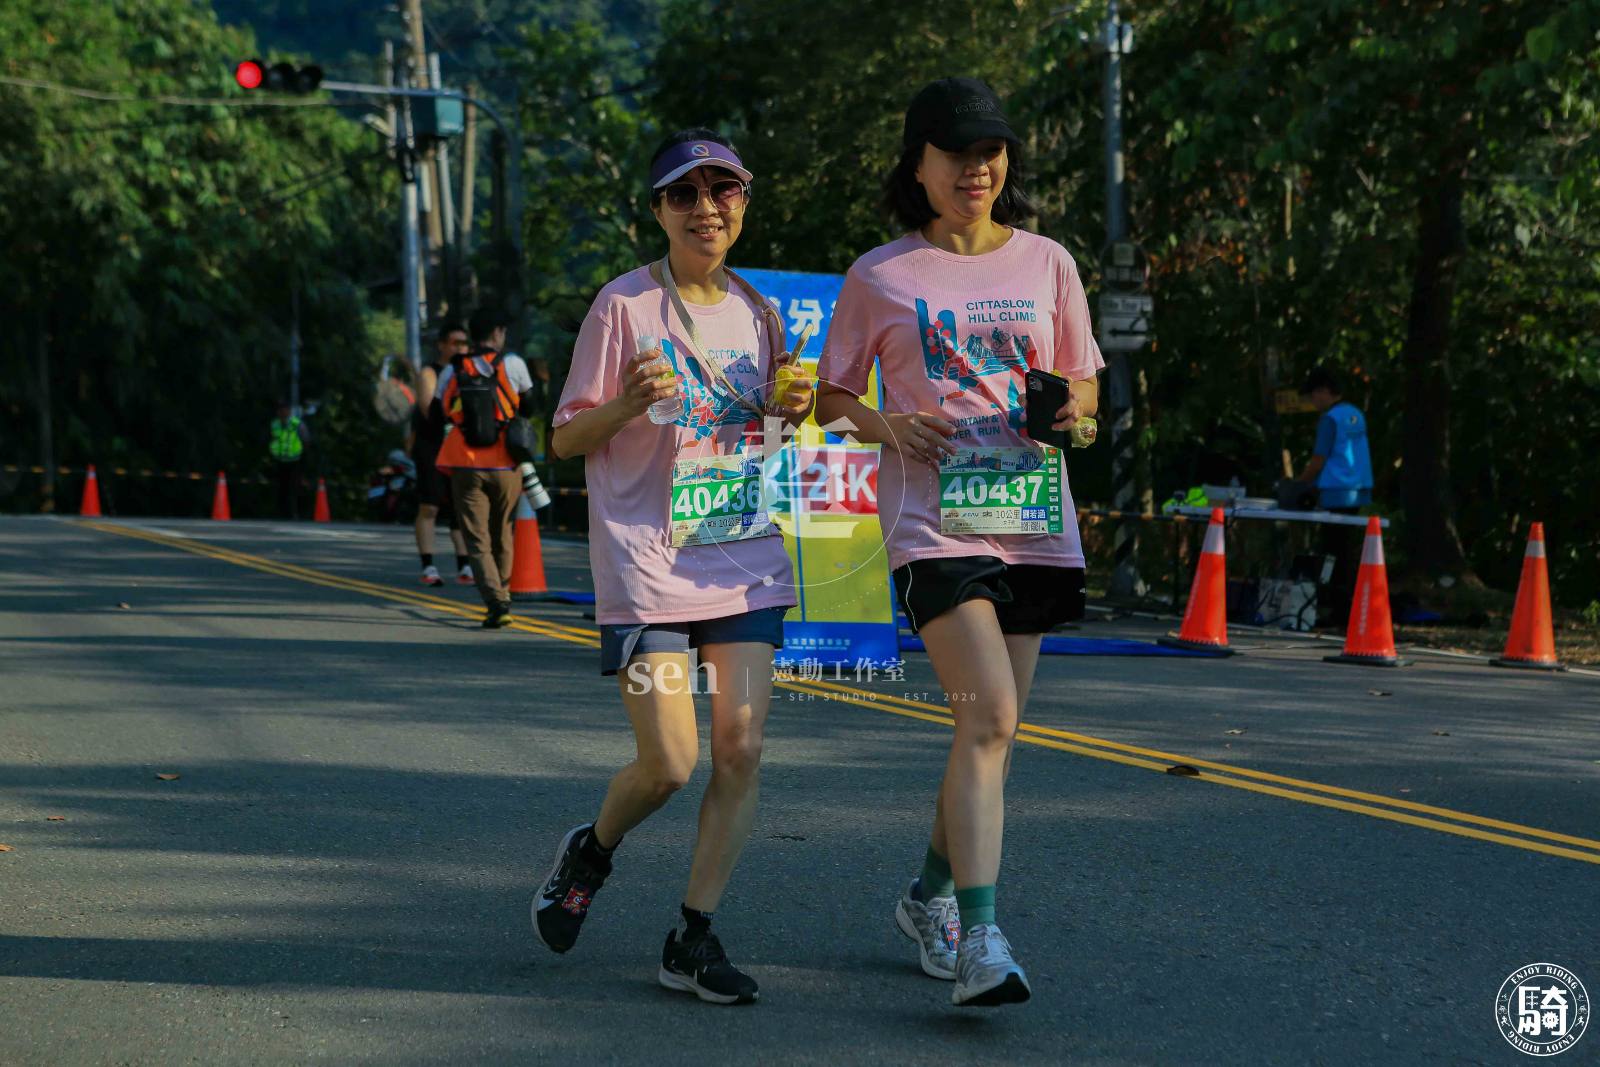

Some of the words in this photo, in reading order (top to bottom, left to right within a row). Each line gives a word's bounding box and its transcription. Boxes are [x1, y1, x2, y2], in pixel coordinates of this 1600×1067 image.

[966, 299, 1035, 311] CITTASLOW
[968, 312, 996, 324] HILL
[947, 415, 989, 428] UNTAIN
[946, 428, 972, 441] VER
[977, 426, 1001, 437] RUN
[807, 462, 878, 503] 21K
[943, 475, 1044, 505] 40437
[674, 480, 762, 517] 40436
